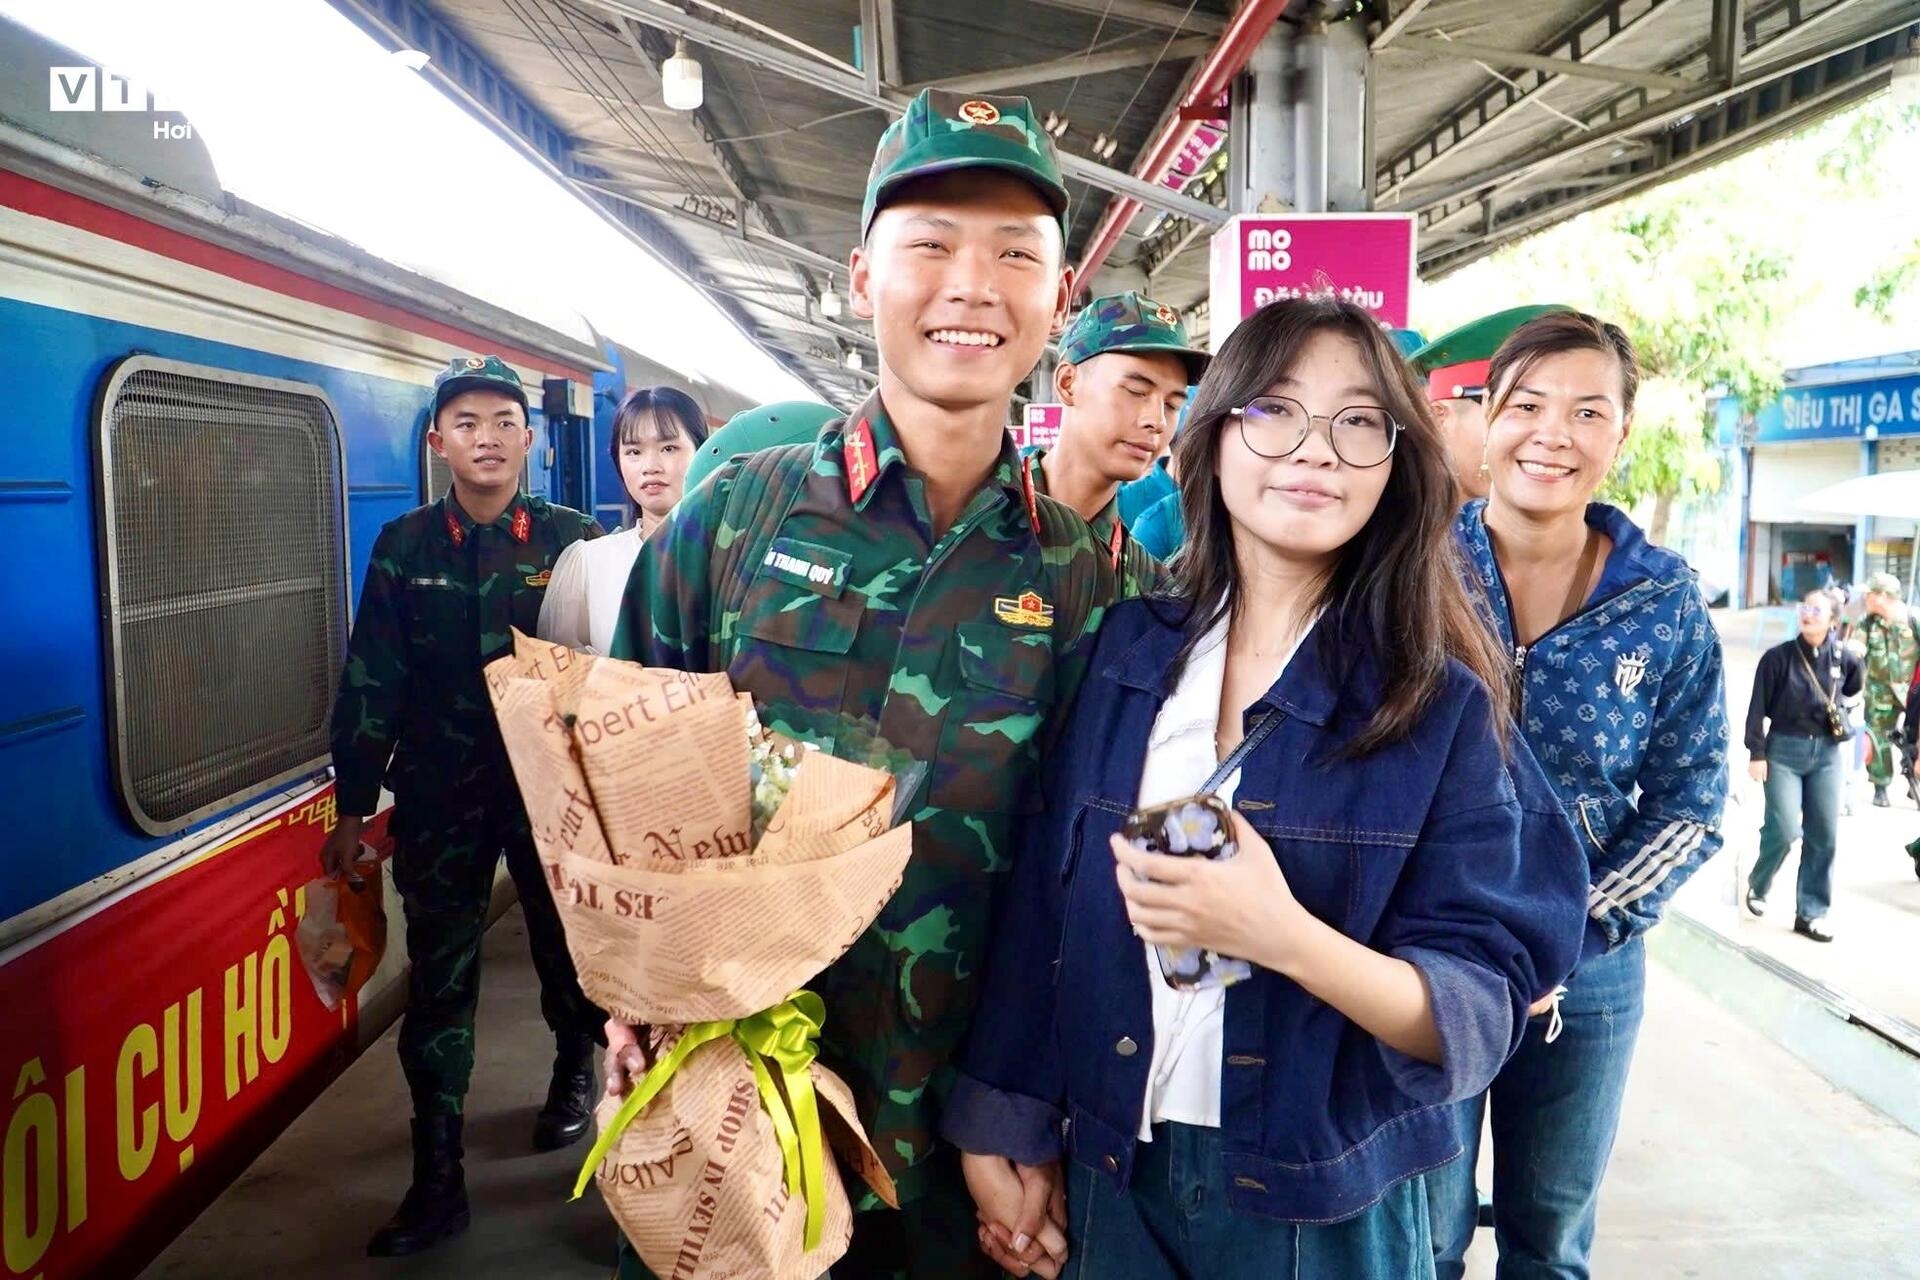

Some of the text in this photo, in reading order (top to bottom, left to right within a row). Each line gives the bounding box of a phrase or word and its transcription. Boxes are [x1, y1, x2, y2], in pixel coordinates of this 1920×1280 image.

[1782, 391, 1824, 430] SIÊU
[1829, 393, 1862, 434] THỊ
[1868, 389, 1904, 424] GA
[116, 987, 202, 1181] CỤ
[224, 888, 291, 1101] HỒ
[716, 1078, 755, 1153] SHOP
[704, 1159, 727, 1193] IN
